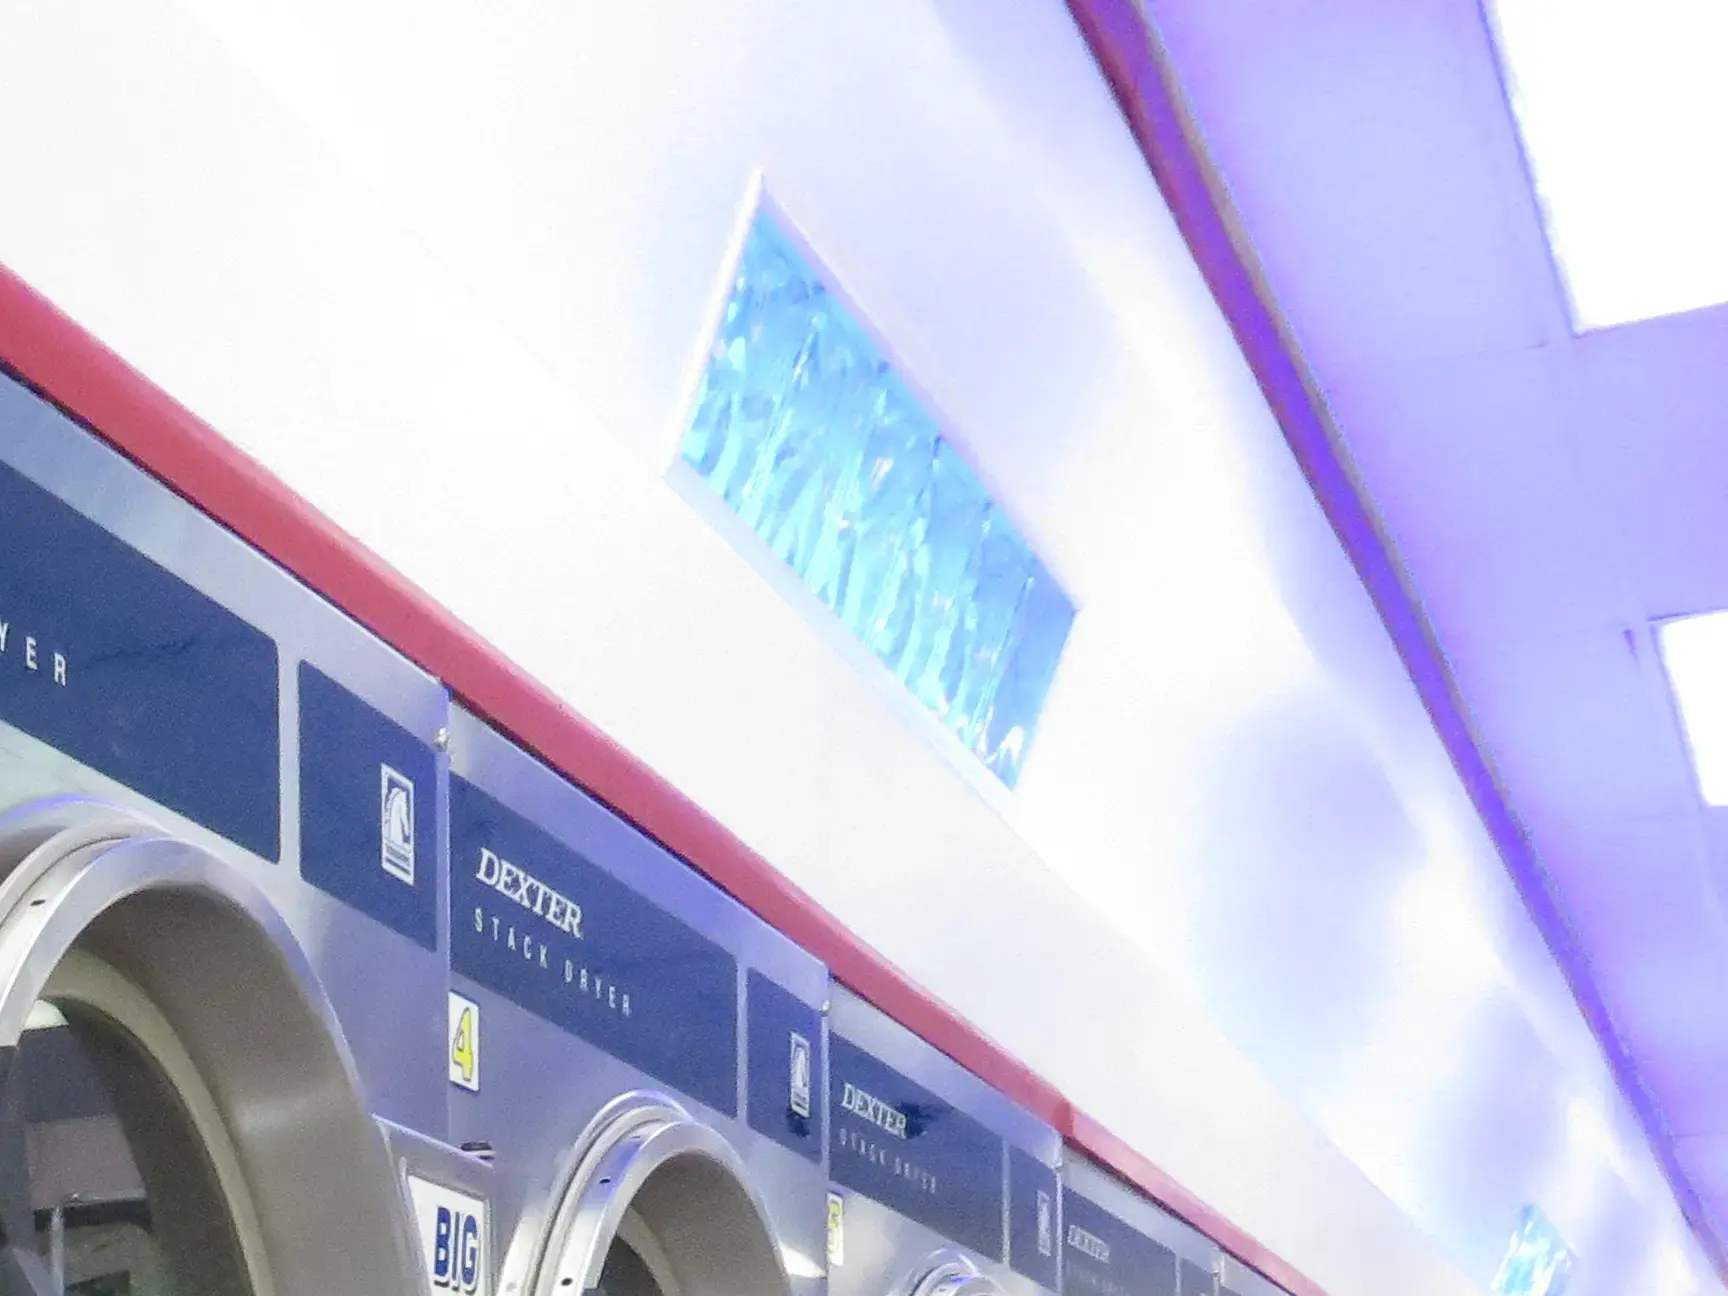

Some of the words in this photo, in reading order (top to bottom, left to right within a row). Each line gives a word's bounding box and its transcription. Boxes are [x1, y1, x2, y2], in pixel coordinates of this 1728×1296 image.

[476, 847, 583, 939] DEXTER
[475, 907, 547, 968] STACK
[565, 959, 631, 1017] DRYER
[452, 1006, 474, 1081] 4
[842, 1083, 907, 1140] DEXTER
[433, 1205, 480, 1295] BIG
